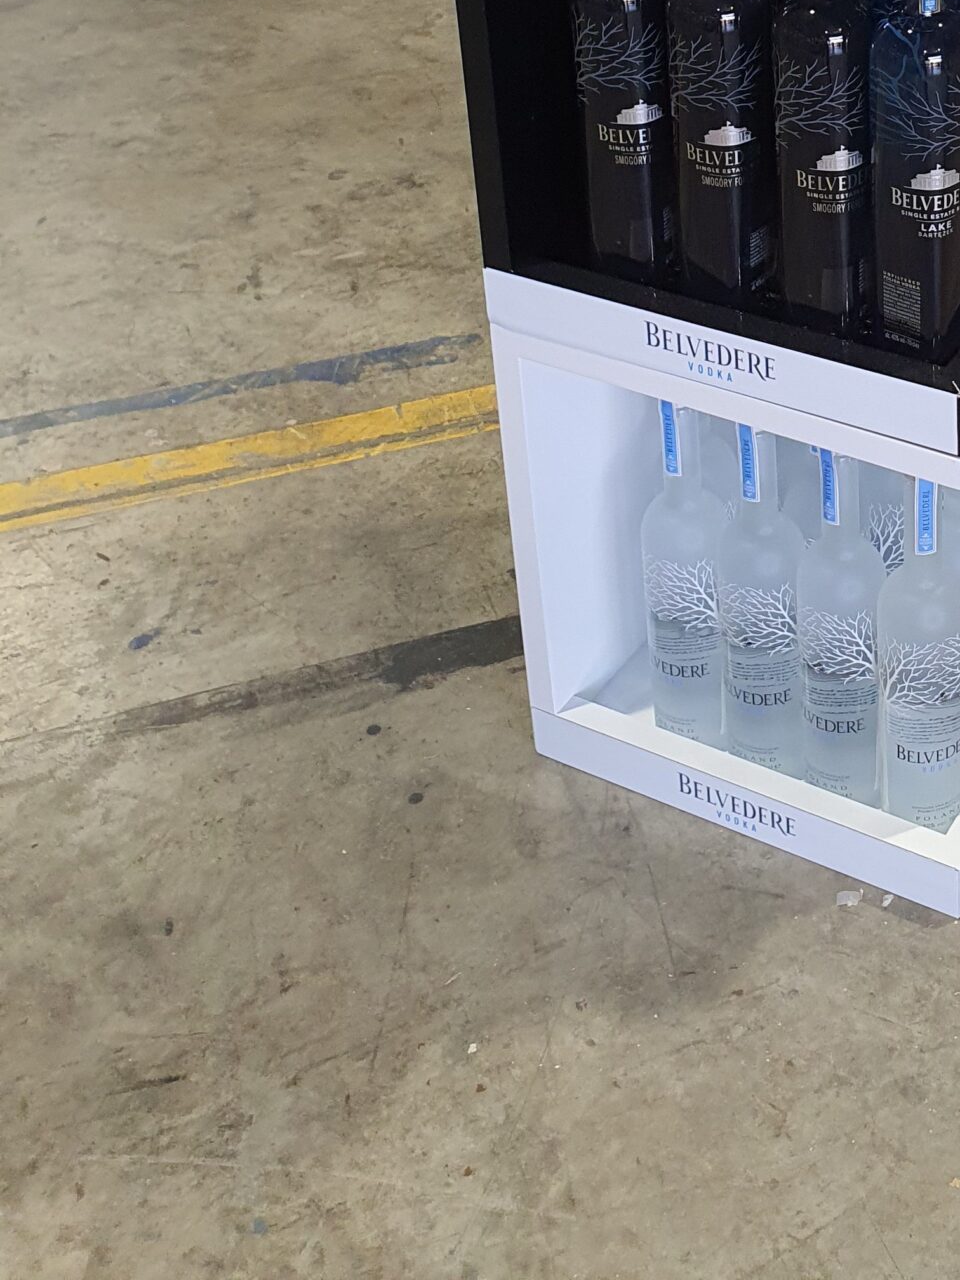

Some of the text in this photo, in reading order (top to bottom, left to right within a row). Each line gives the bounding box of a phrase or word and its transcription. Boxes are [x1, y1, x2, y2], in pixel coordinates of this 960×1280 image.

[597, 123, 650, 144] BELVE
[806, 191, 832, 199] SINGLE
[901, 209, 928, 220] SINGLE
[930, 209, 955, 220] ESTATE
[921, 220, 952, 232] LAKE
[644, 320, 776, 381] BELVEDERE
[687, 361, 733, 382] VODKA
[677, 772, 797, 837] BELVEDERE
[716, 810, 757, 833] VODKA
